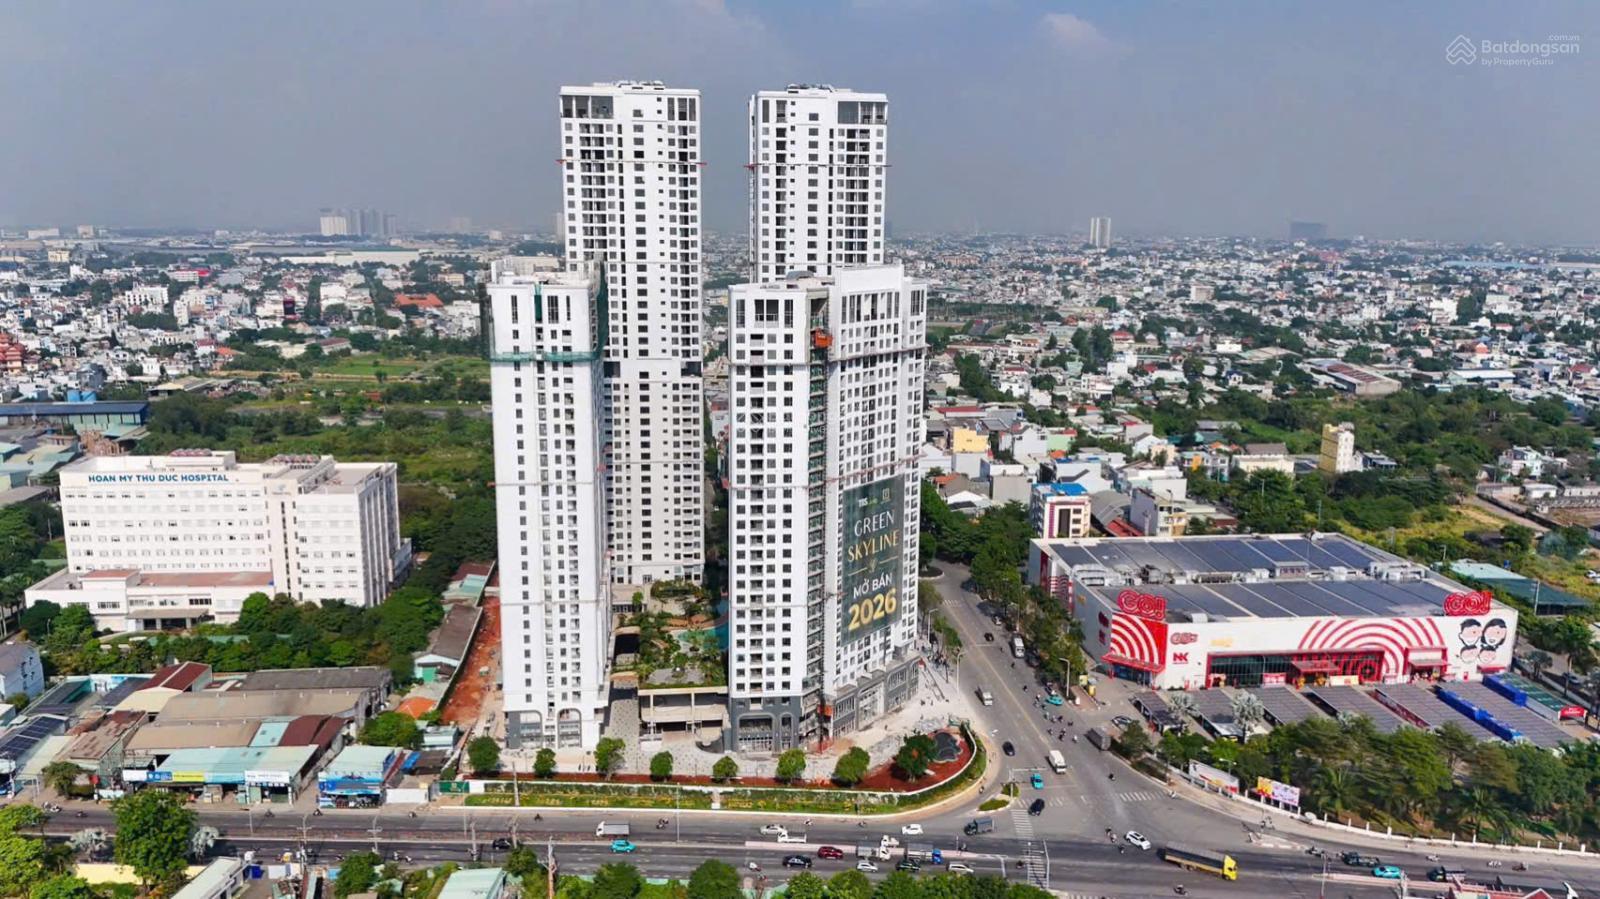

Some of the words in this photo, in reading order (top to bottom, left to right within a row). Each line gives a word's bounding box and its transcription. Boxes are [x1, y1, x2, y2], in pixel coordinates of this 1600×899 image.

[181, 474, 229, 482] HOSPITAL
[854, 510, 895, 537] GREEN
[847, 529, 900, 563] SKYLINE
[853, 578, 870, 599] MỞ
[872, 572, 893, 591] BÁN
[848, 588, 897, 631] 2026
[1117, 589, 1166, 620] GO!
